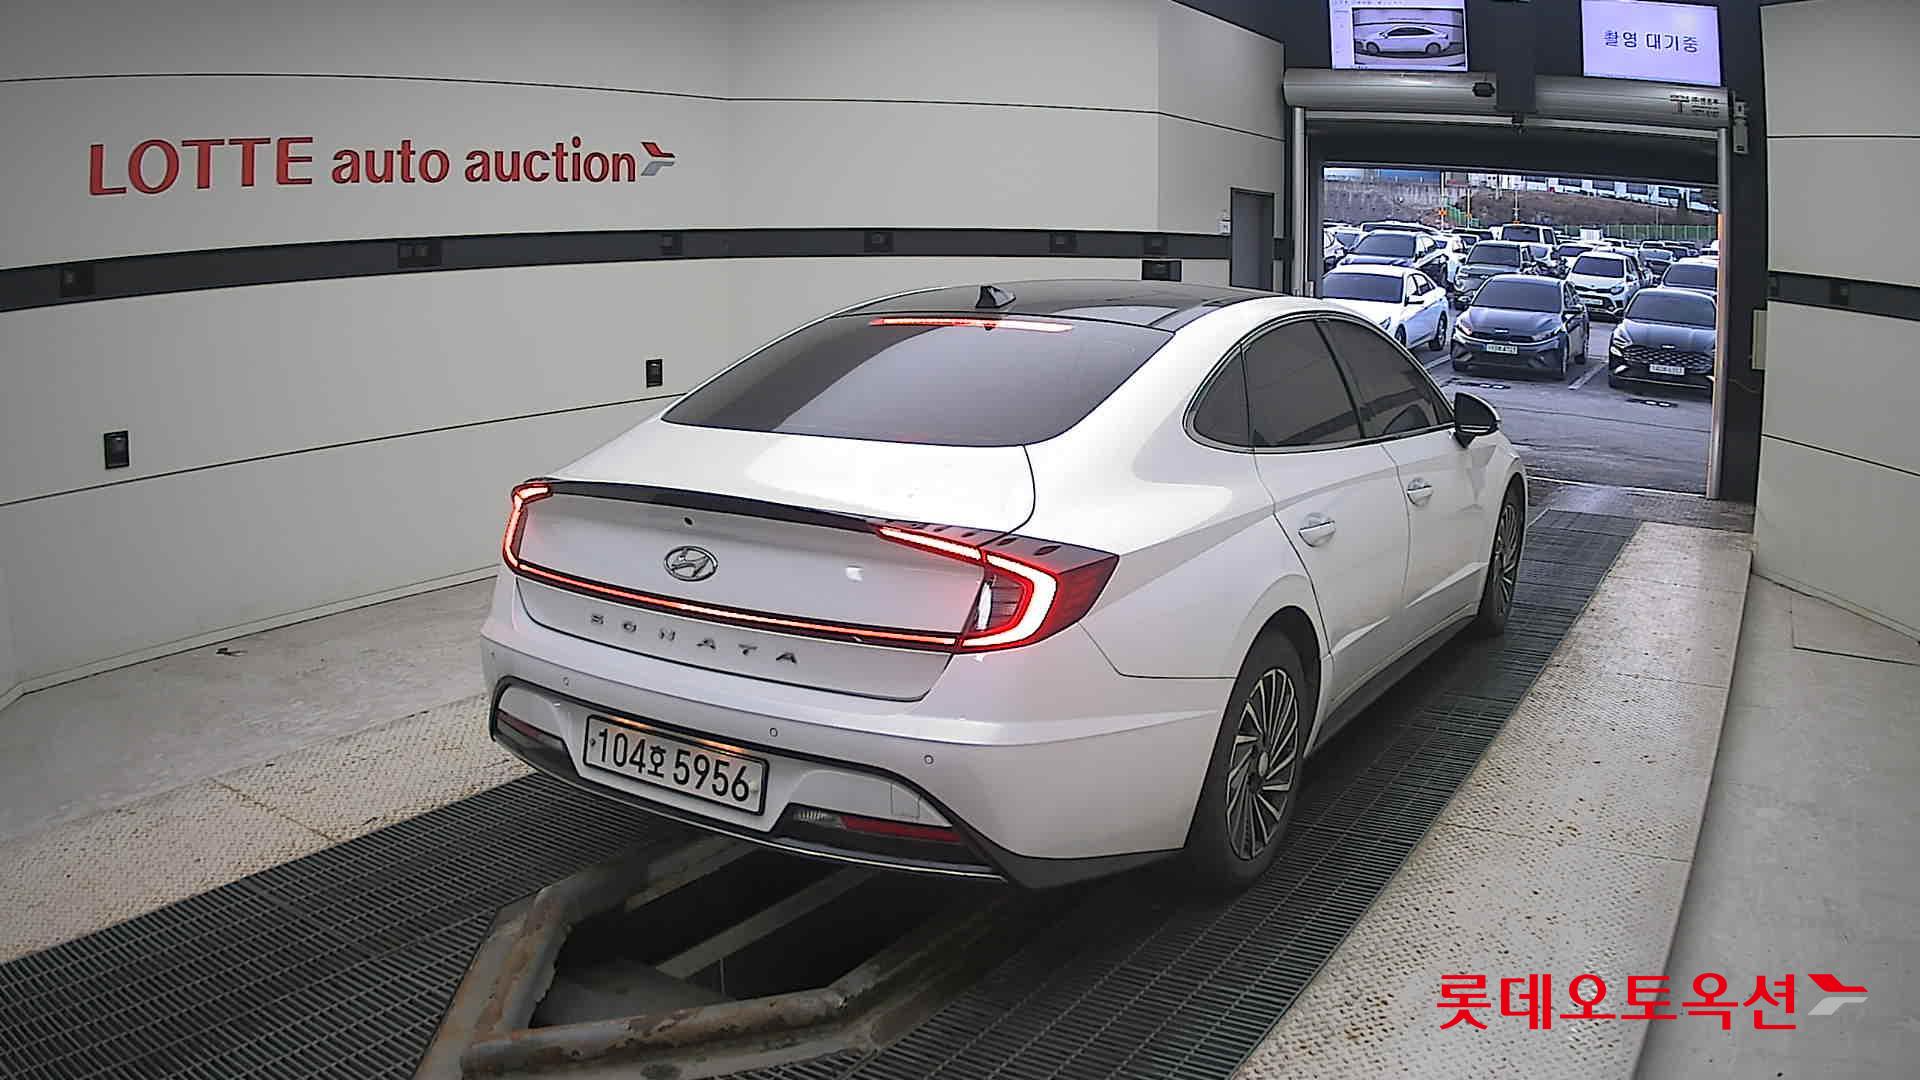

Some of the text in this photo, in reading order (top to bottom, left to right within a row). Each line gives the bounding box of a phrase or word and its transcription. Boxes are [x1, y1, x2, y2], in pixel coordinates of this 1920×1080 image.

[1646, 33, 1698, 53] 대기중
[89, 135, 637, 195] LOTTE auto auction
[591, 615, 797, 664] SONATA
[673, 748, 749, 802] 5956
